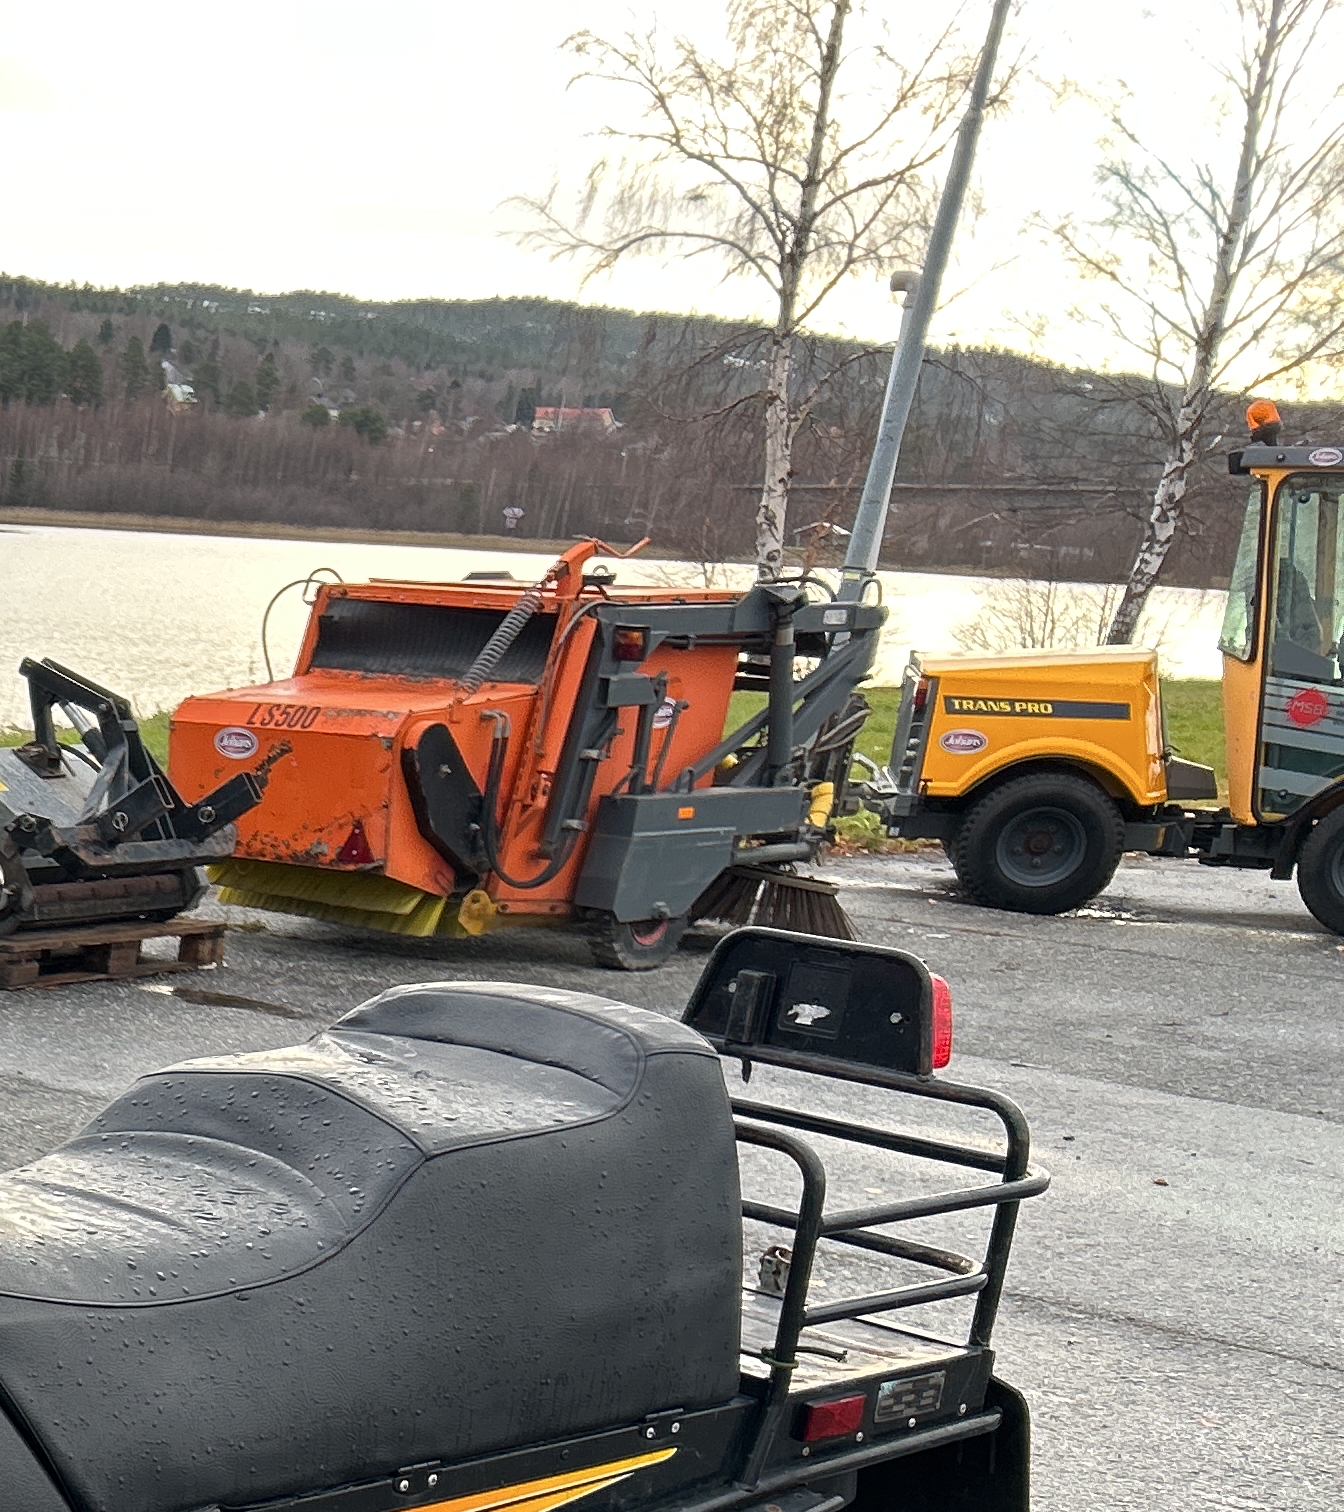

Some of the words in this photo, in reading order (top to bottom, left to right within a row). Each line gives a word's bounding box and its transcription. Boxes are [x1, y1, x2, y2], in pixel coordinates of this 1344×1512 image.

[951, 698, 1011, 712] TRANS
[1014, 702, 1053, 714] PRO
[1291, 700, 1325, 715] MSB
[245, 702, 322, 729] LS500
